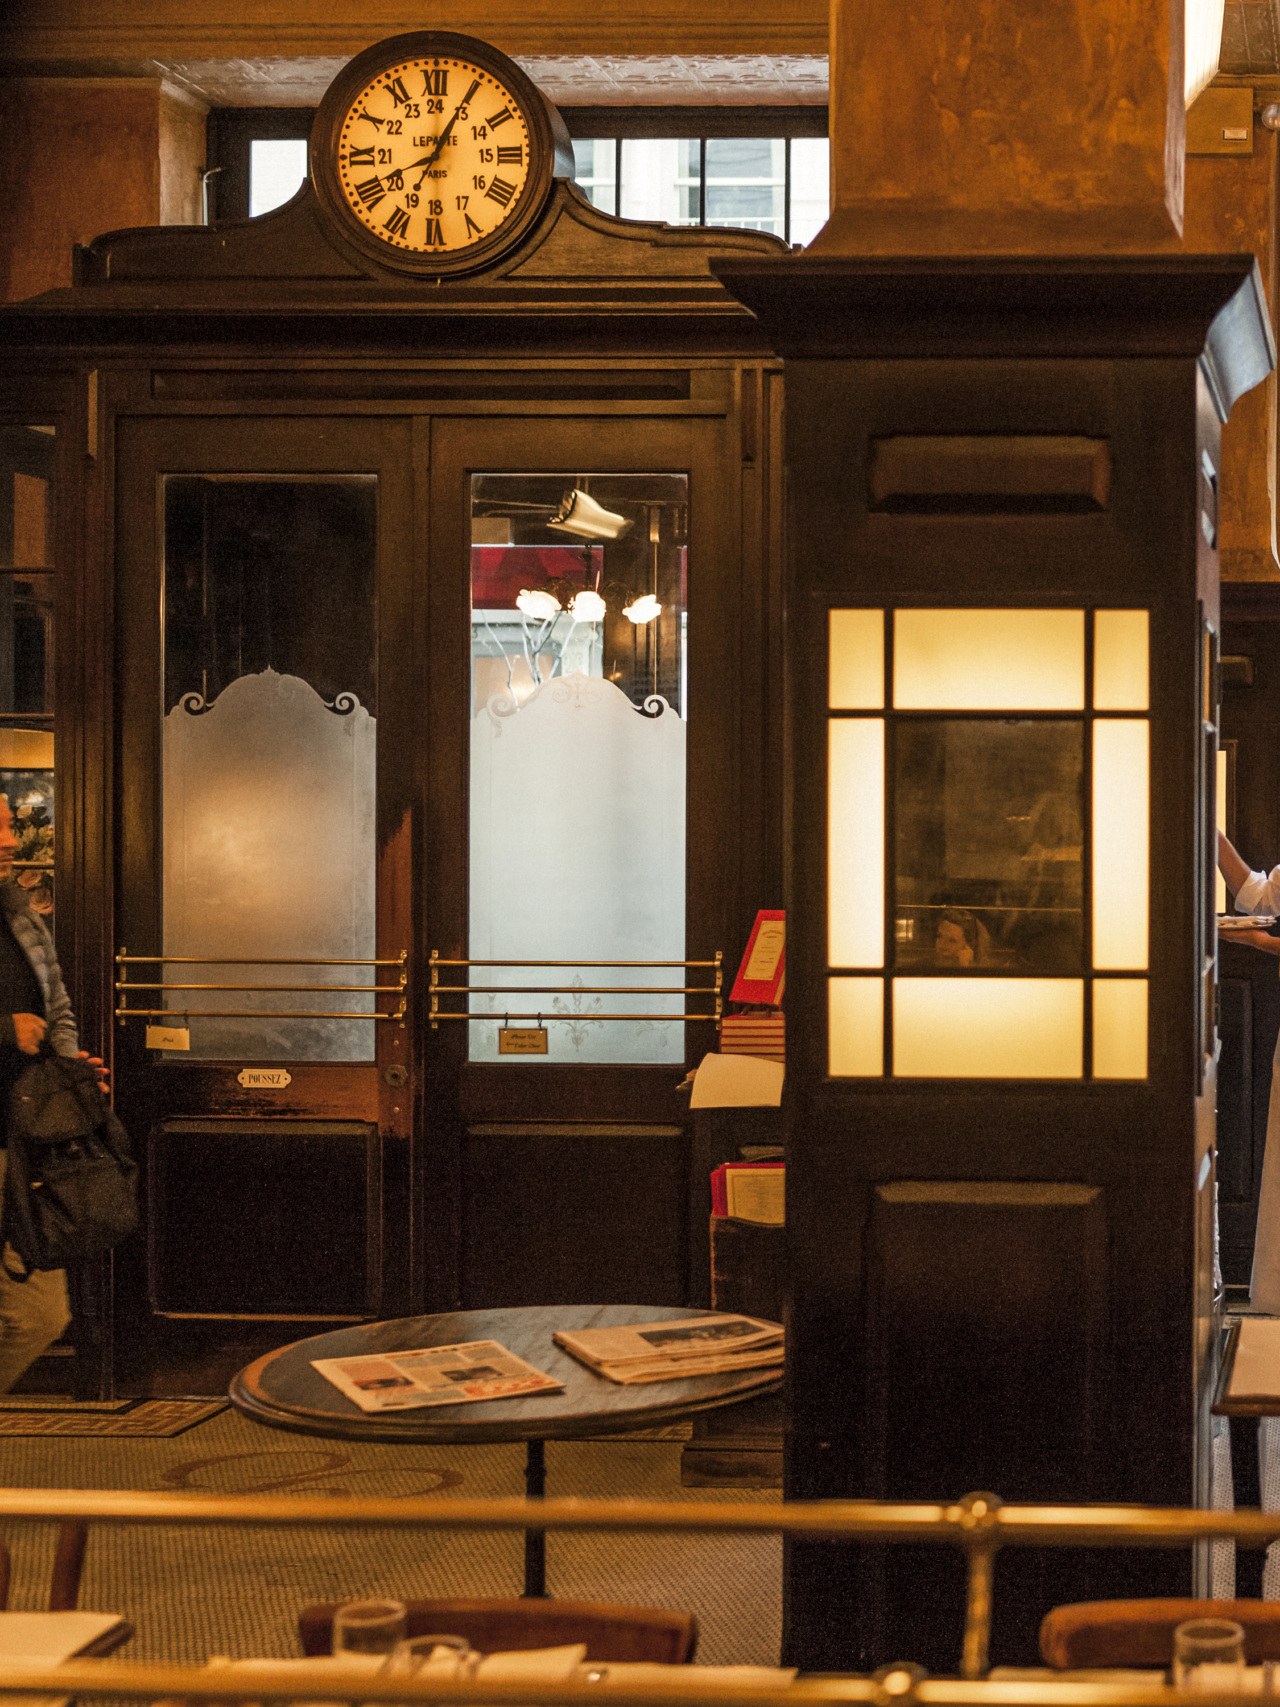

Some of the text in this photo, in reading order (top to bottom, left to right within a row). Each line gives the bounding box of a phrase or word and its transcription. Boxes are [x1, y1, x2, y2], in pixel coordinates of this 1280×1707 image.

[420, 69, 449, 96] XII
[383, 76, 412, 108] XI
[405, 103, 420, 118] 23
[427, 98, 444, 114] 24
[357, 107, 385, 132] X
[485, 106, 514, 131] II
[386, 120, 403, 135] 22
[471, 126, 487, 140] 14
[413, 135, 457, 147] LEPATE
[350, 145, 375, 167] IX
[378, 148, 392, 164] 21
[479, 148, 494, 163] 15
[497, 144, 523, 166] III
[386, 174, 404, 192] 20
[472, 175, 486, 190] 16
[404, 193, 420, 209] 19
[427, 200, 443, 215] 18
[455, 195, 469, 210] 17
[382, 205, 411, 239] VII
[464, 213, 483, 239] V
[424, 218, 446, 246] VI
[249, 1074, 281, 1084] POUSSEZ
